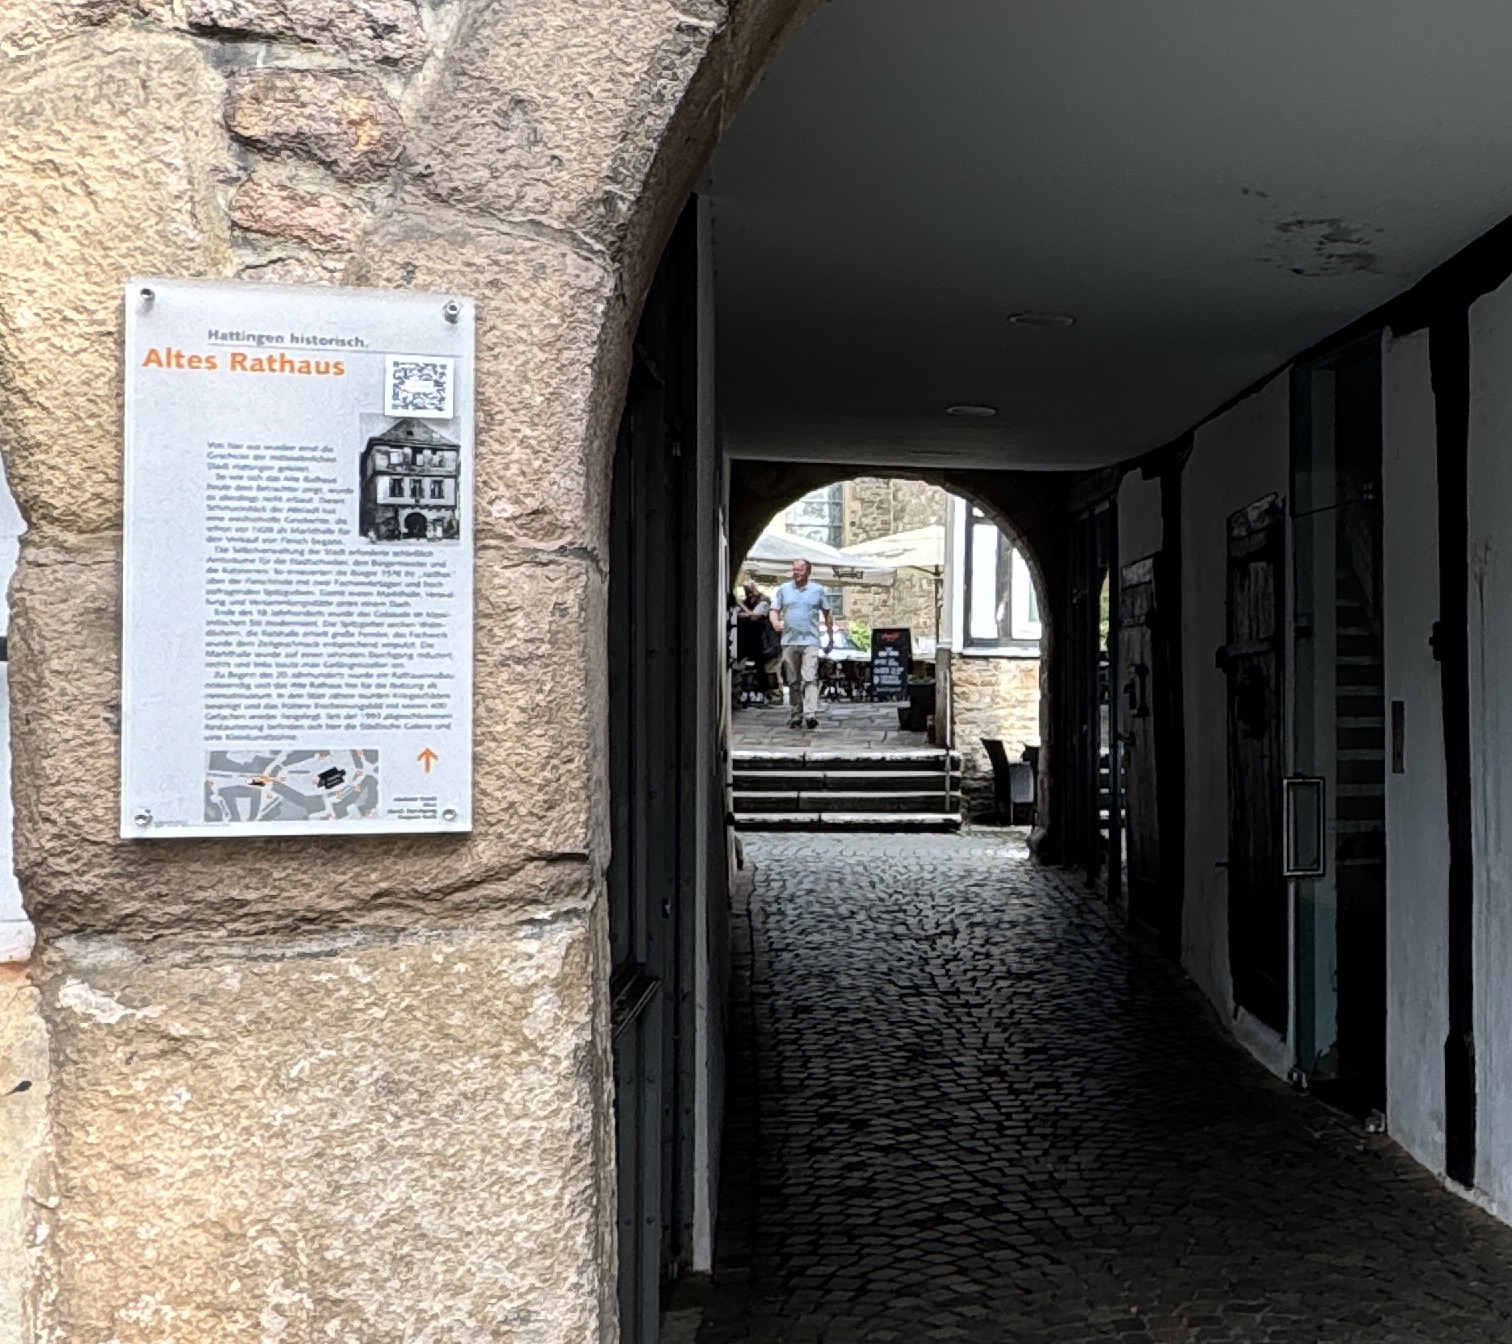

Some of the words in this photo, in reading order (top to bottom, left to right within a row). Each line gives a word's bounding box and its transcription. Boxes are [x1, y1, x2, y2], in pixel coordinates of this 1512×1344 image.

[208, 329, 284, 346] Hattingen
[142, 347, 218, 370] Altes
[230, 352, 346, 376] Rathaus
